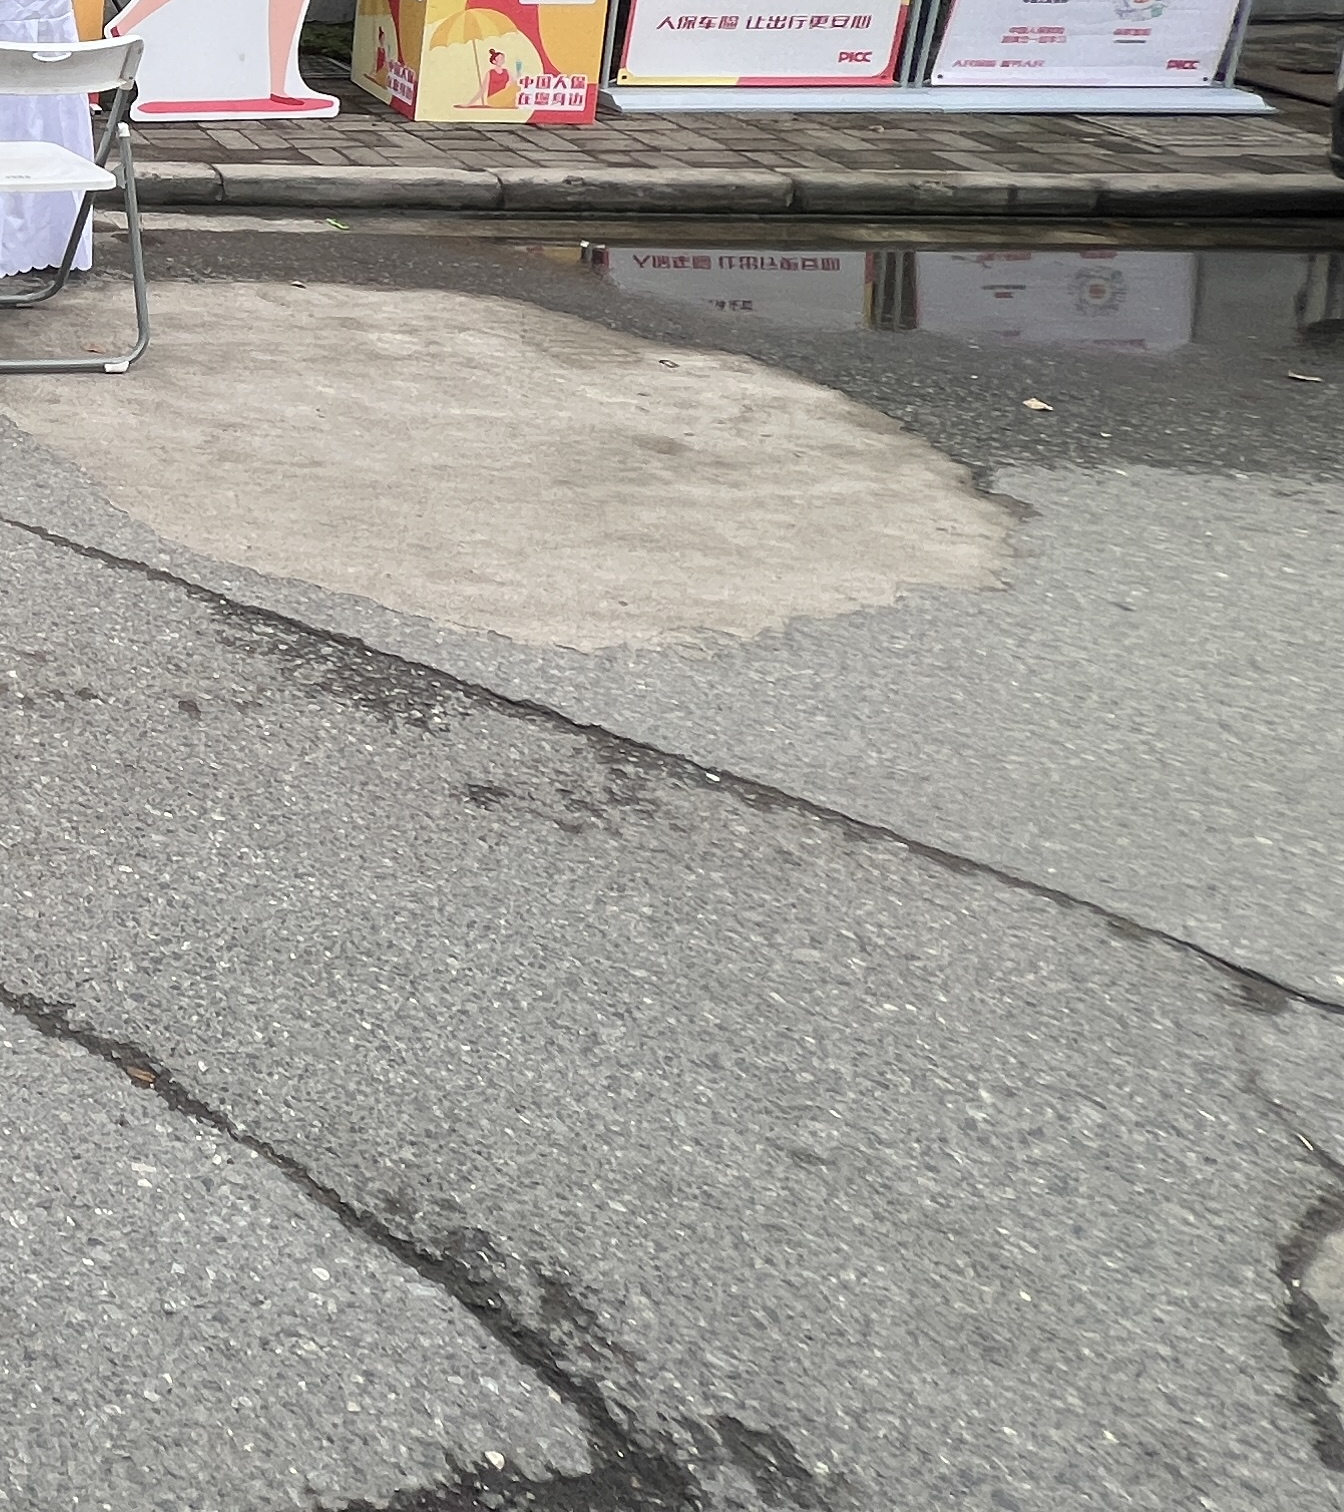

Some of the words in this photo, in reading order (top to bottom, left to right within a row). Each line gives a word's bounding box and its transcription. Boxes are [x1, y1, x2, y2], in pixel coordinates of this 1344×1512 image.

[656, 15, 739, 30] 人保车险
[745, 14, 872, 29] 让出行更安心
[838, 51, 872, 63] PICC
[519, 75, 586, 89] 中国人保
